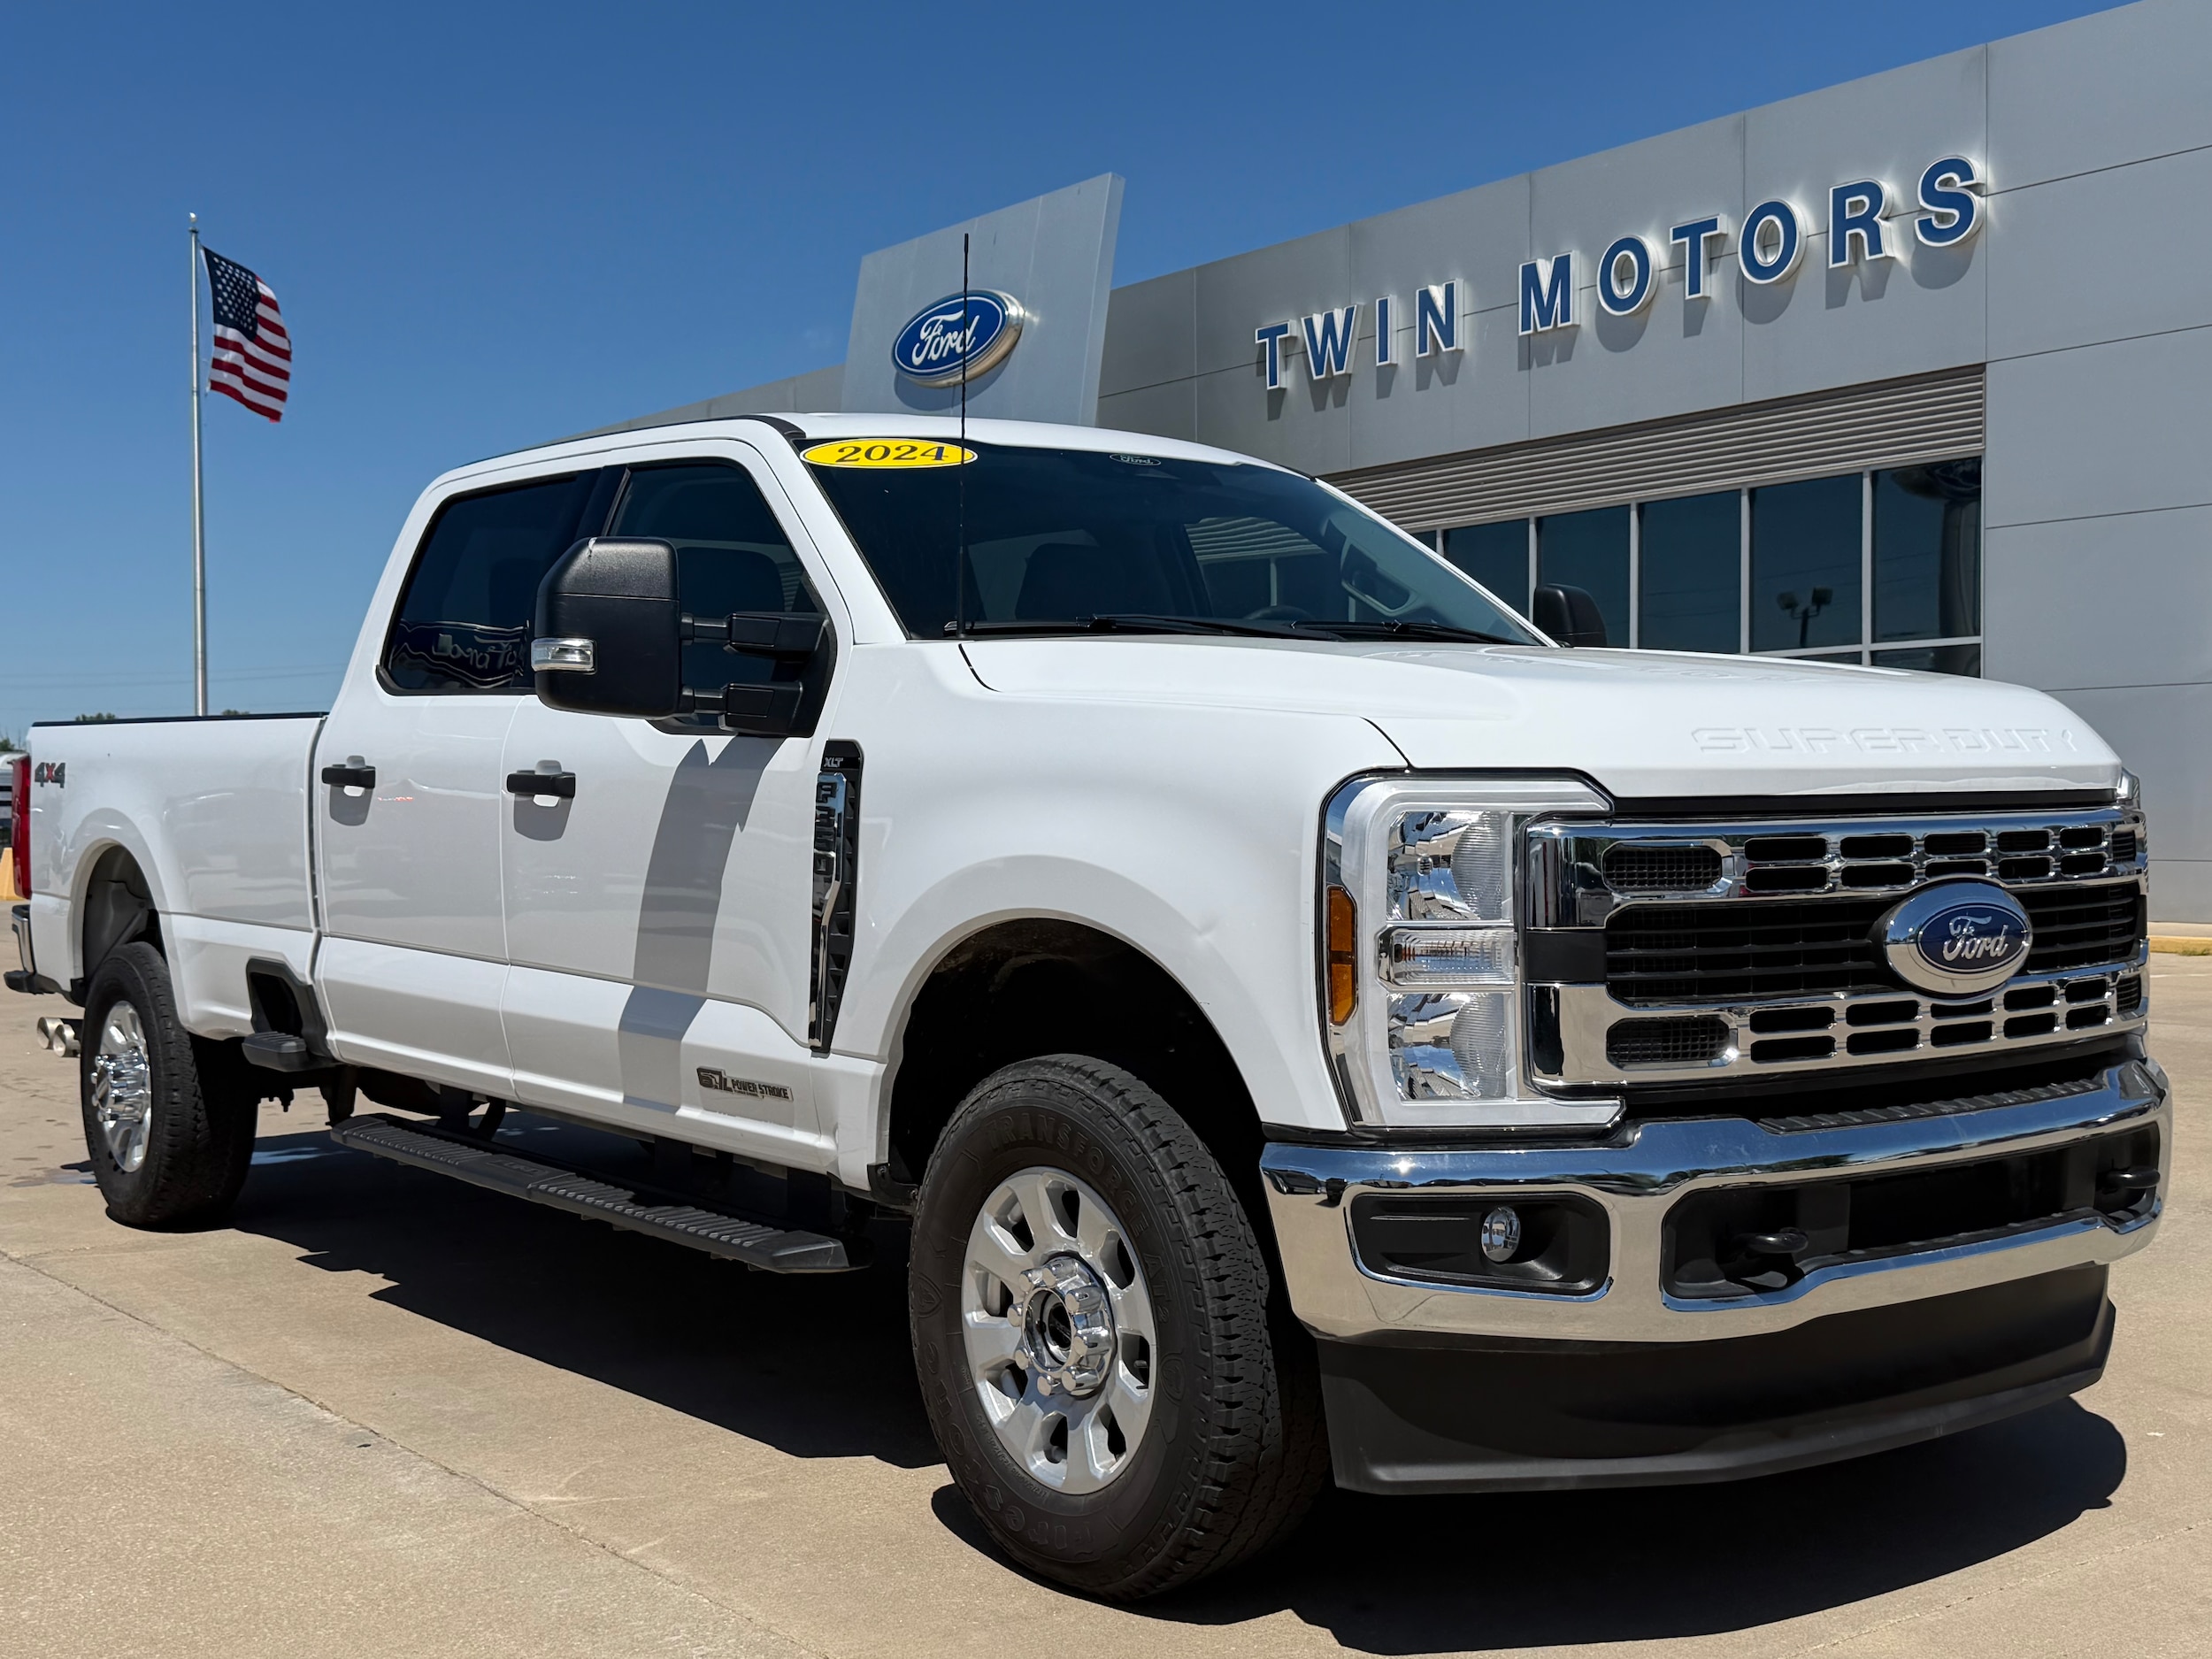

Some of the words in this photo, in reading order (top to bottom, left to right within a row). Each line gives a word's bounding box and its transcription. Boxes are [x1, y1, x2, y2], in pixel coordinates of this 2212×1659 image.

[1255, 278, 1463, 390] TWIN
[1518, 155, 1985, 336] MOTORS
[911, 309, 980, 366] Ford
[836, 445, 949, 464] 2024
[823, 757, 844, 768] XLT
[1691, 726, 1939, 754] SUPER
[1943, 727, 2078, 754] DUTY
[1942, 914, 2008, 962] Ford
[732, 1079, 758, 1094] POWER
[757, 1084, 789, 1099] STROKE
[984, 1112, 1149, 1239] TRANSFORCE
[925, 1340, 1095, 1555] Firestone
